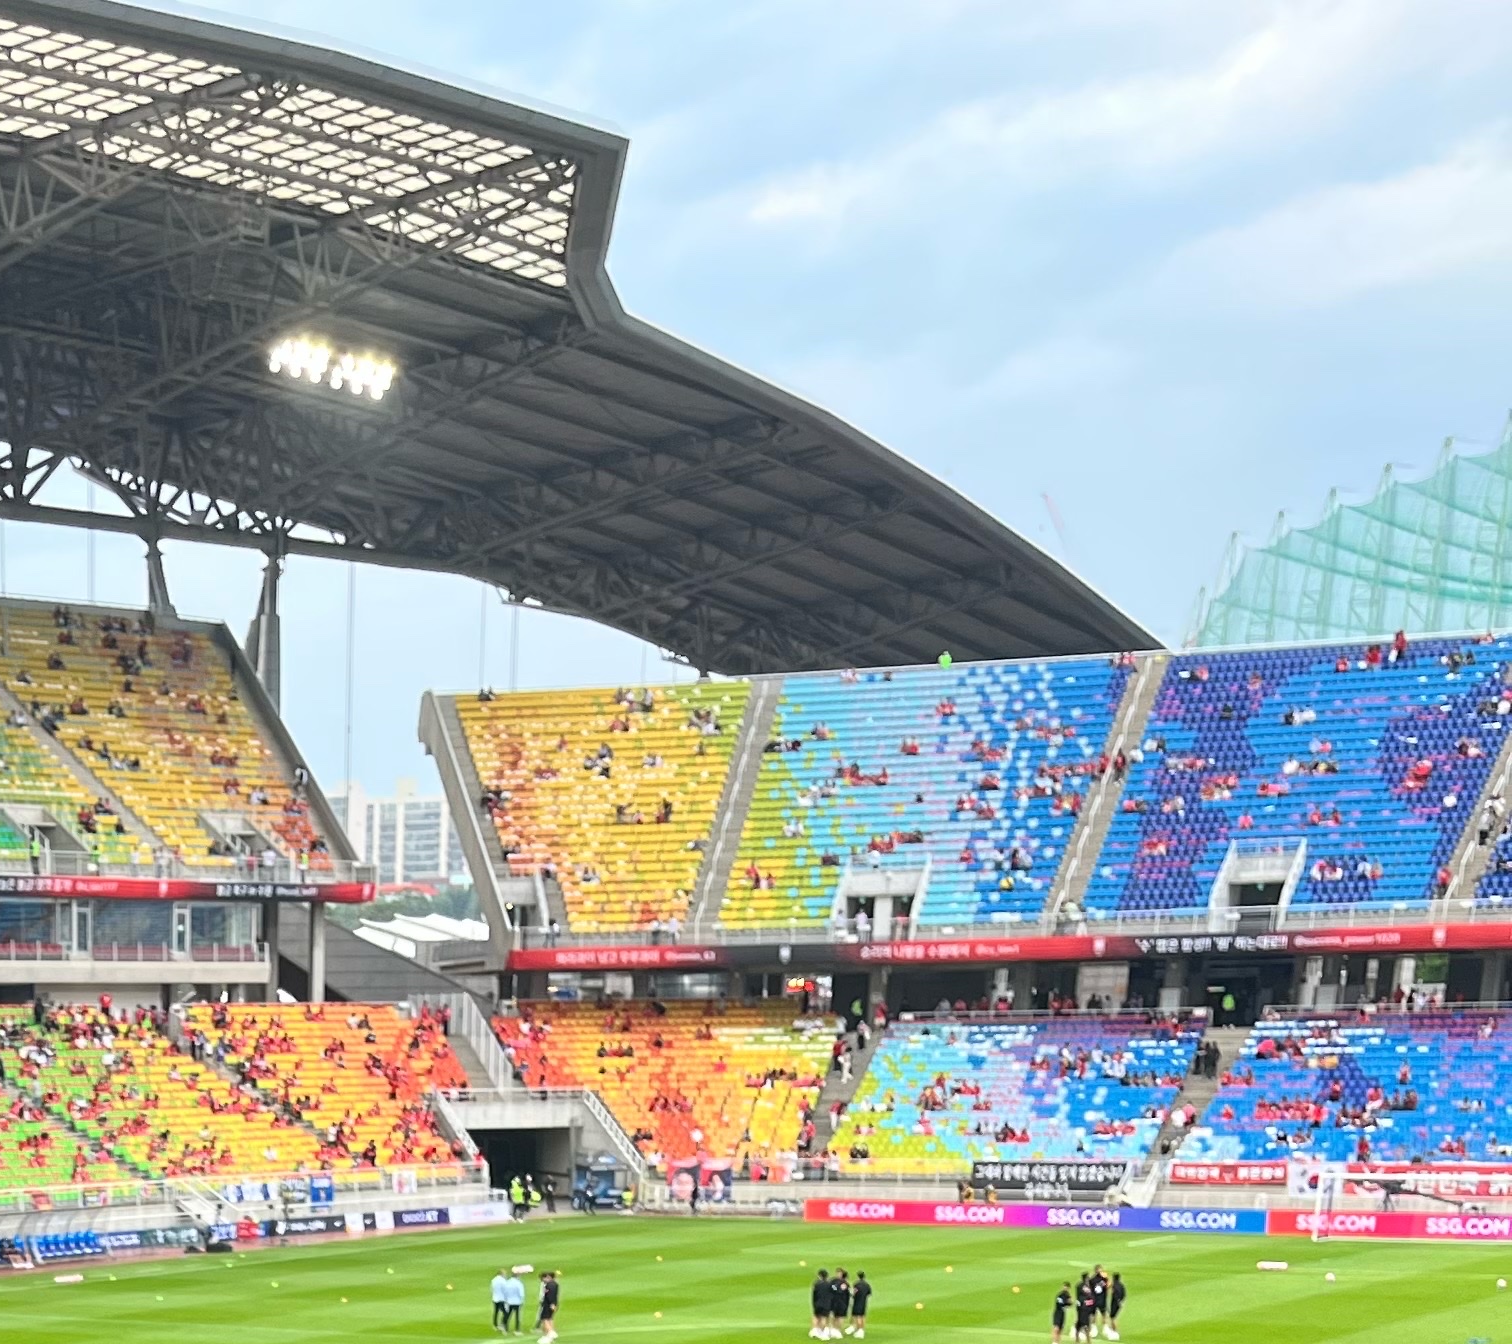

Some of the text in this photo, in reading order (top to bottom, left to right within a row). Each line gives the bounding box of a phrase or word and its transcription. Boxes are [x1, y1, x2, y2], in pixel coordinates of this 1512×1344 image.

[829, 1202, 895, 1219] SSG.COM
[934, 1205, 1004, 1223] SSG.COM
[1046, 1207, 1120, 1227] SSG.COM
[1159, 1210, 1237, 1230] SSG.COM
[1425, 1216, 1510, 1236] SSG.COM
